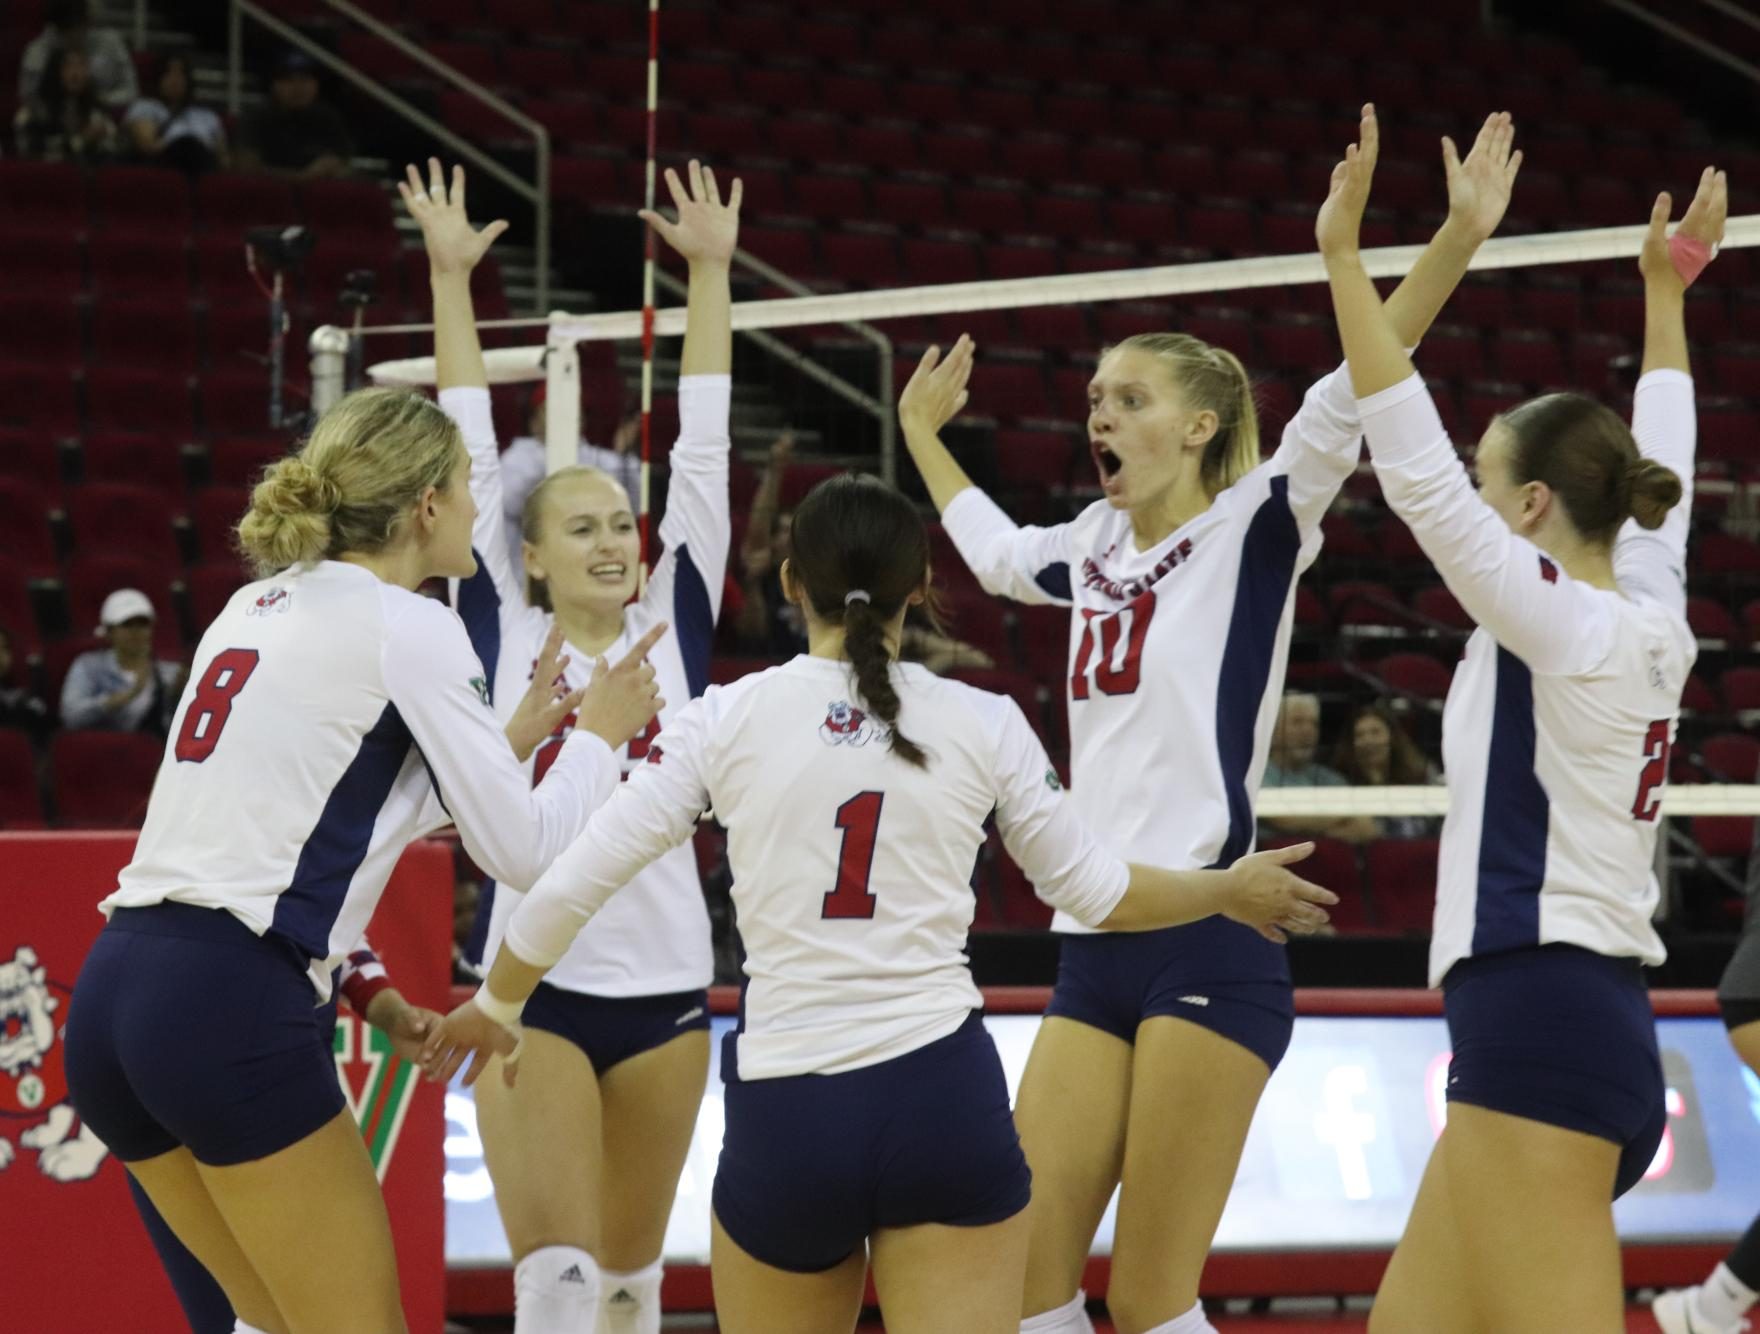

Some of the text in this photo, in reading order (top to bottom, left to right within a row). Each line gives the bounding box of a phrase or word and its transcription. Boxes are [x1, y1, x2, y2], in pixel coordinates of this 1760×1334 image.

[1071, 588, 1157, 701] 10
[175, 647, 260, 764] 8
[1631, 718, 1671, 822] 2
[821, 790, 885, 919] 1
